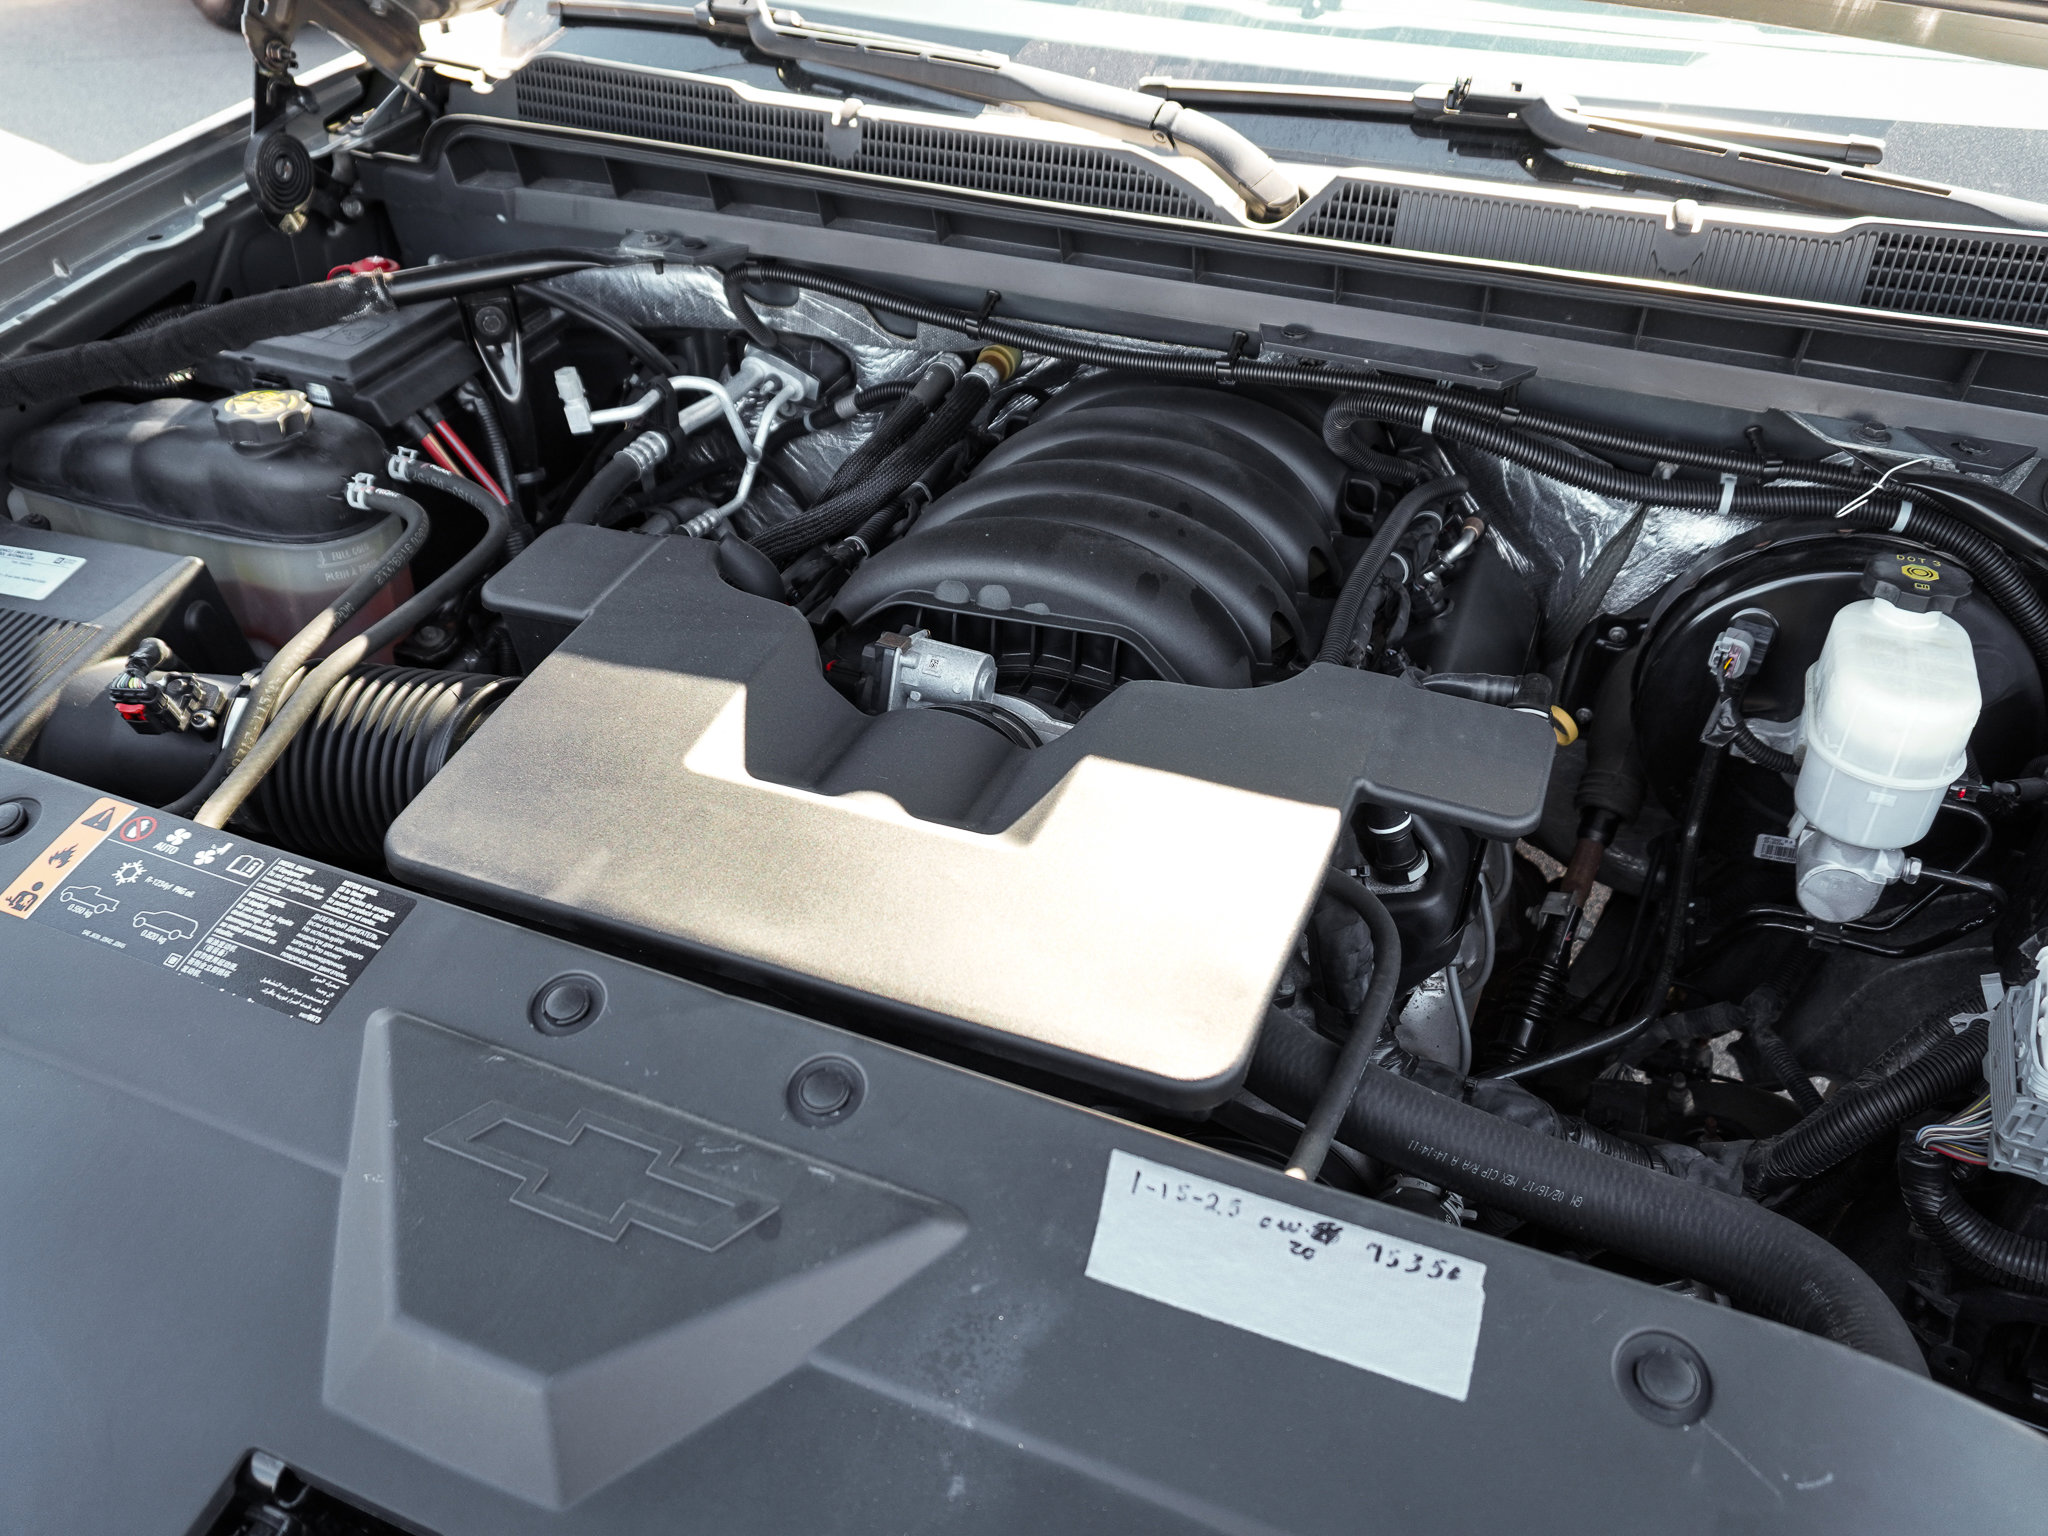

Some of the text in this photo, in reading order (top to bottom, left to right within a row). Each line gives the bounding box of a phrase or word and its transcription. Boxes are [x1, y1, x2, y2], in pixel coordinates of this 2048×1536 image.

[1896, 554, 1926, 564] DOT
[153, 842, 180, 855] AUTO
[145, 876, 175, 890] R-1234yf
[83, 910, 93, 919] kg
[157, 936, 167, 945] kg
[1408, 1140, 1448, 1162] 14:14:11
[1450, 1155, 1460, 1166] A
[1462, 1158, 1480, 1174] R/A
[1480, 1167, 1499, 1180] CIP
[1522, 1180, 1564, 1202] 02/16/17
[1570, 1194, 1583, 1208] GM
